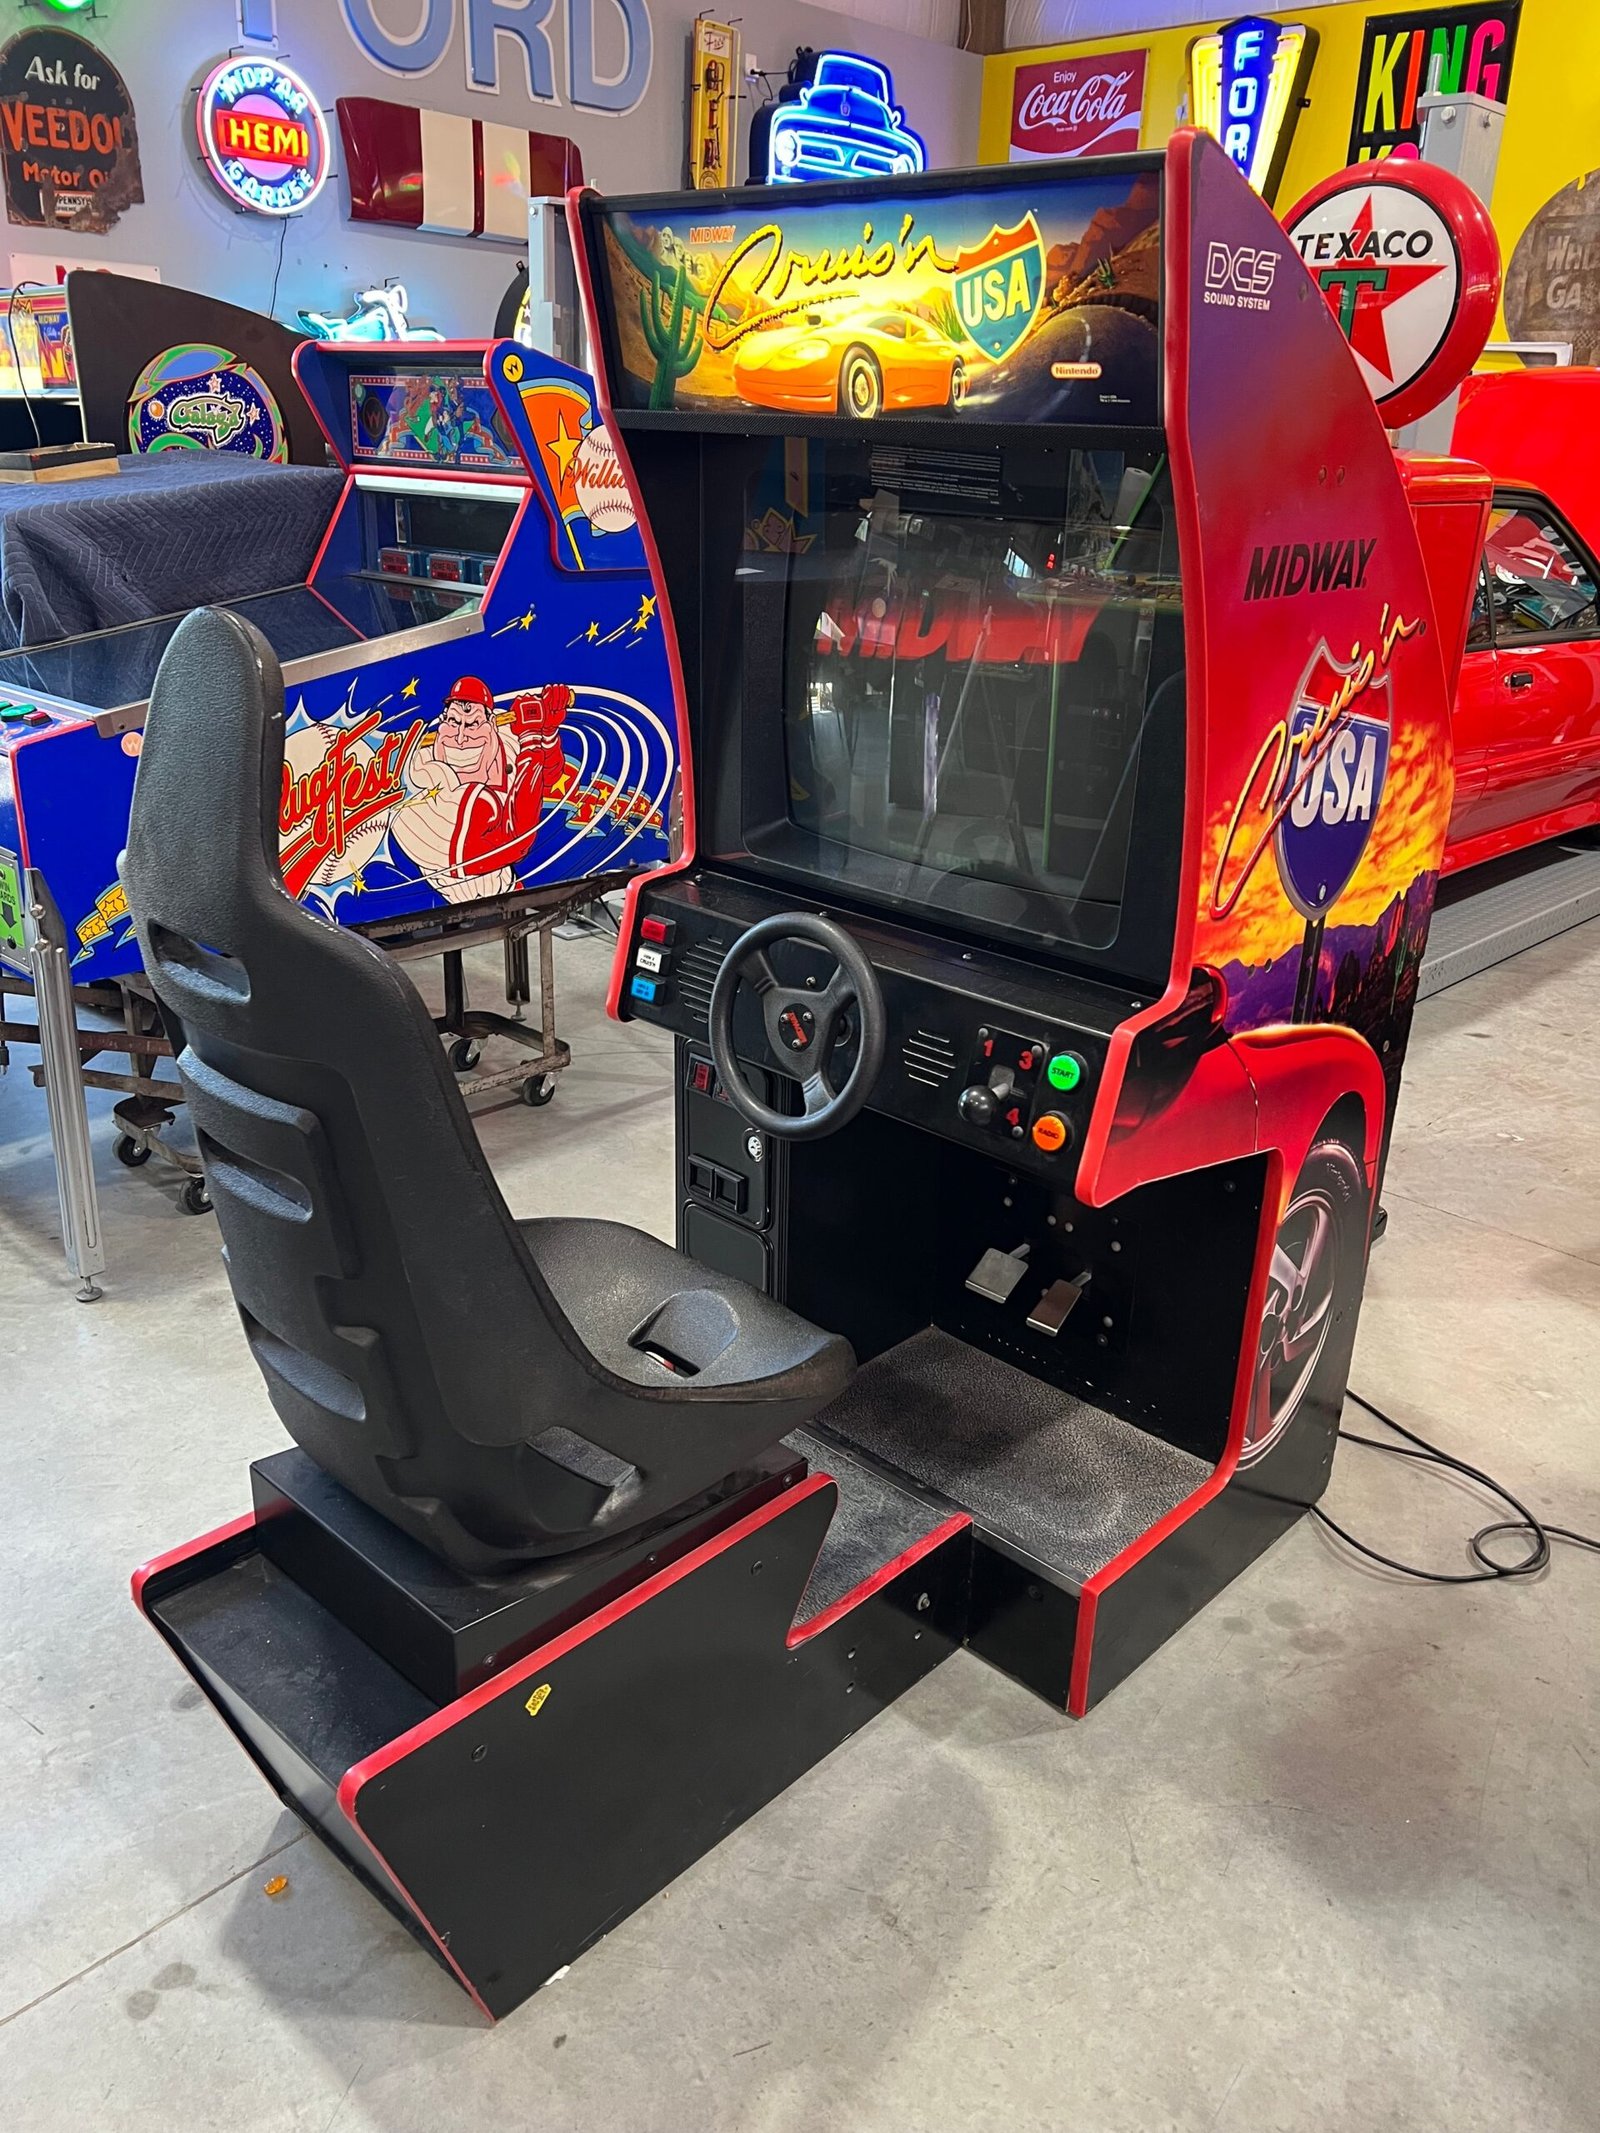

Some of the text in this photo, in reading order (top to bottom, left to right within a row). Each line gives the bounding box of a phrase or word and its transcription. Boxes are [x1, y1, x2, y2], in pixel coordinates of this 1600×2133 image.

[25, 56, 101, 91] Ask for
[238, 0, 655, 118] ORD
[1362, 19, 1506, 133] KING
[217, 66, 309, 116] MOPAR
[1053, 71, 1077, 84] Enjoy
[1018, 69, 1135, 131] Coca-Cola
[1224, 30, 1264, 176] FOR
[229, 118, 309, 158] HEMI
[88, 168, 110, 189] Oi
[224, 160, 315, 208] GARAGE
[689, 226, 737, 245] MIDWAY
[1297, 229, 1434, 260] TEXACO
[1205, 241, 1277, 295] DCS
[962, 258, 1032, 328] USA
[1203, 291, 1271, 311] SOUND SYSTEM
[1055, 366, 1099, 376] Nintendo
[566, 456, 628, 489] Willia
[1243, 537, 1377, 601] MIDWAY
[1290, 723, 1378, 828] USA
[984, 1039, 994, 1057] 1
[1018, 1051, 1033, 1070] 3
[1051, 1066, 1075, 1080] START
[1005, 1107, 1020, 1126] 4
